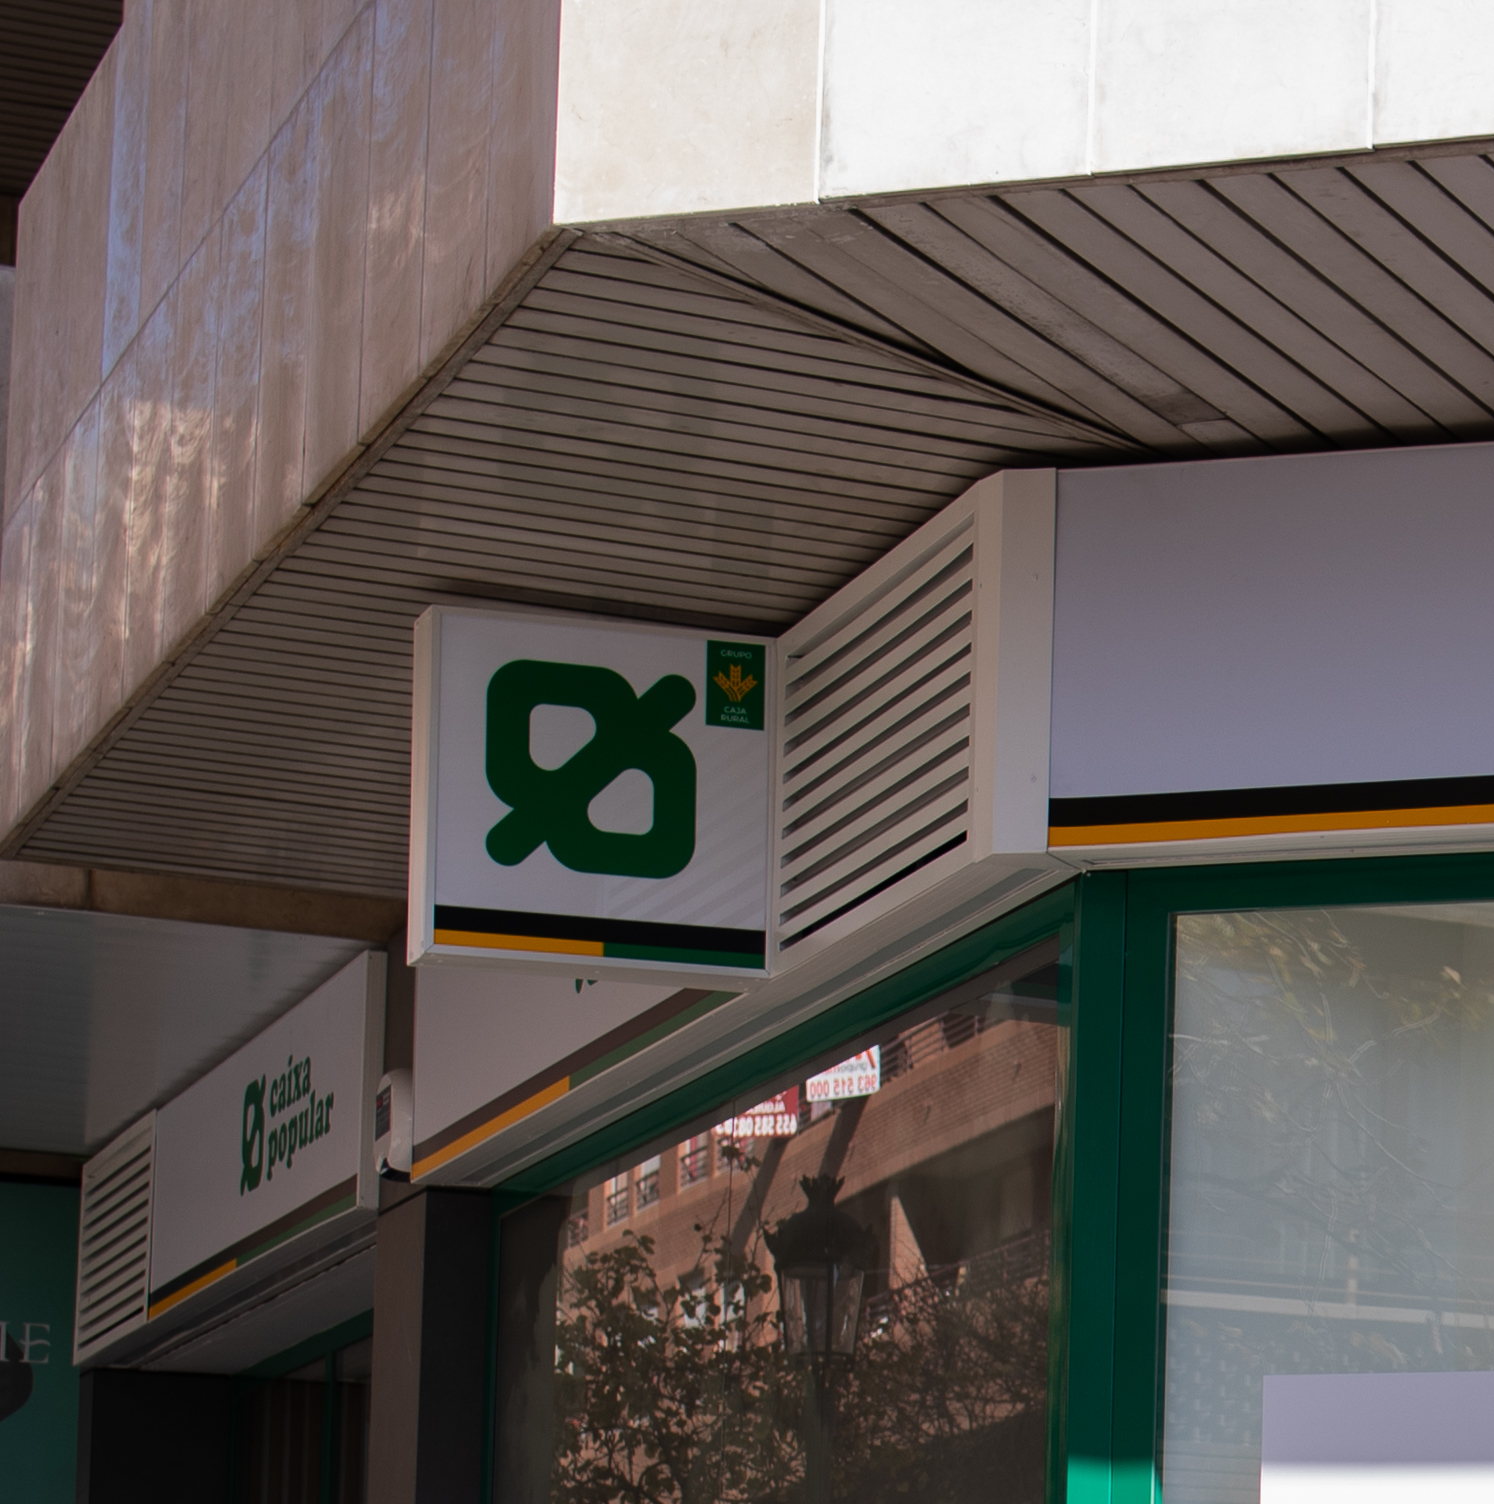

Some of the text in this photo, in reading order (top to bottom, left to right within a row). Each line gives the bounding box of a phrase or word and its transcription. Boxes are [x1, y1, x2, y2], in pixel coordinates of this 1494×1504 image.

[720, 649, 752, 660] GRUPO
[723, 705, 747, 715] CAJA
[720, 714, 750, 724] RURAL
[269, 1054, 311, 1118] caixa
[266, 1089, 335, 1182] popular
